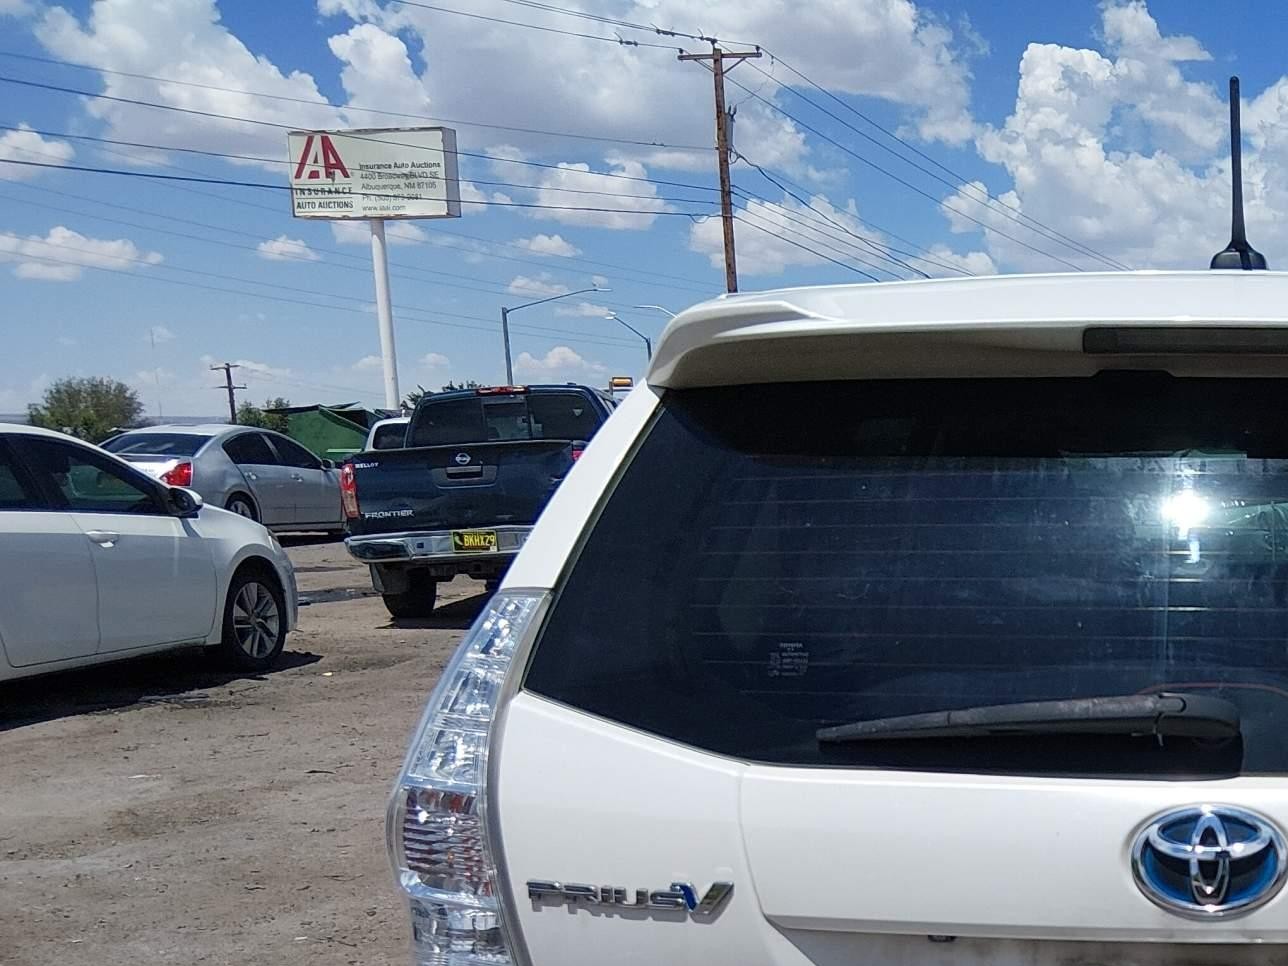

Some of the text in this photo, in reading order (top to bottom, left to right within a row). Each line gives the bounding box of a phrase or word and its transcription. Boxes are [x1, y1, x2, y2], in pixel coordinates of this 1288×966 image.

[359, 161, 441, 170] Insurance Auto Auctions
[295, 187, 353, 196] INSURANCE
[296, 200, 354, 209] AUTO AUCTIONS
[364, 510, 415, 519] FRONTIER
[527, 879, 686, 913] PRIUS
